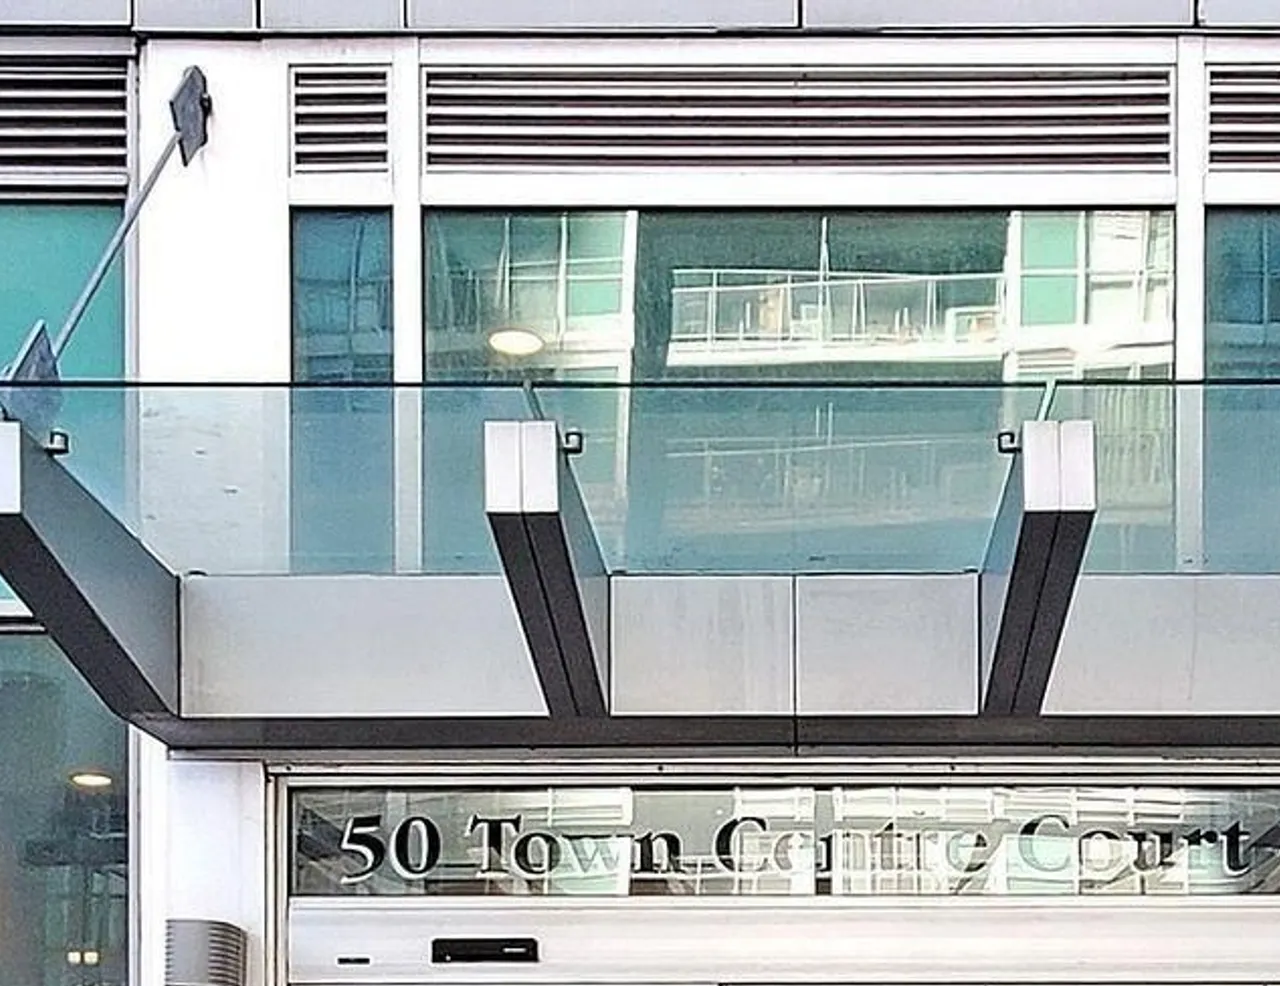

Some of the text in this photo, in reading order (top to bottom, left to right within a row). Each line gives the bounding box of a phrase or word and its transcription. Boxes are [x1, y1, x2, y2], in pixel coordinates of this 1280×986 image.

[338, 813, 442, 886] 50
[465, 813, 688, 880] Town
[1018, 813, 1253, 878] Court
